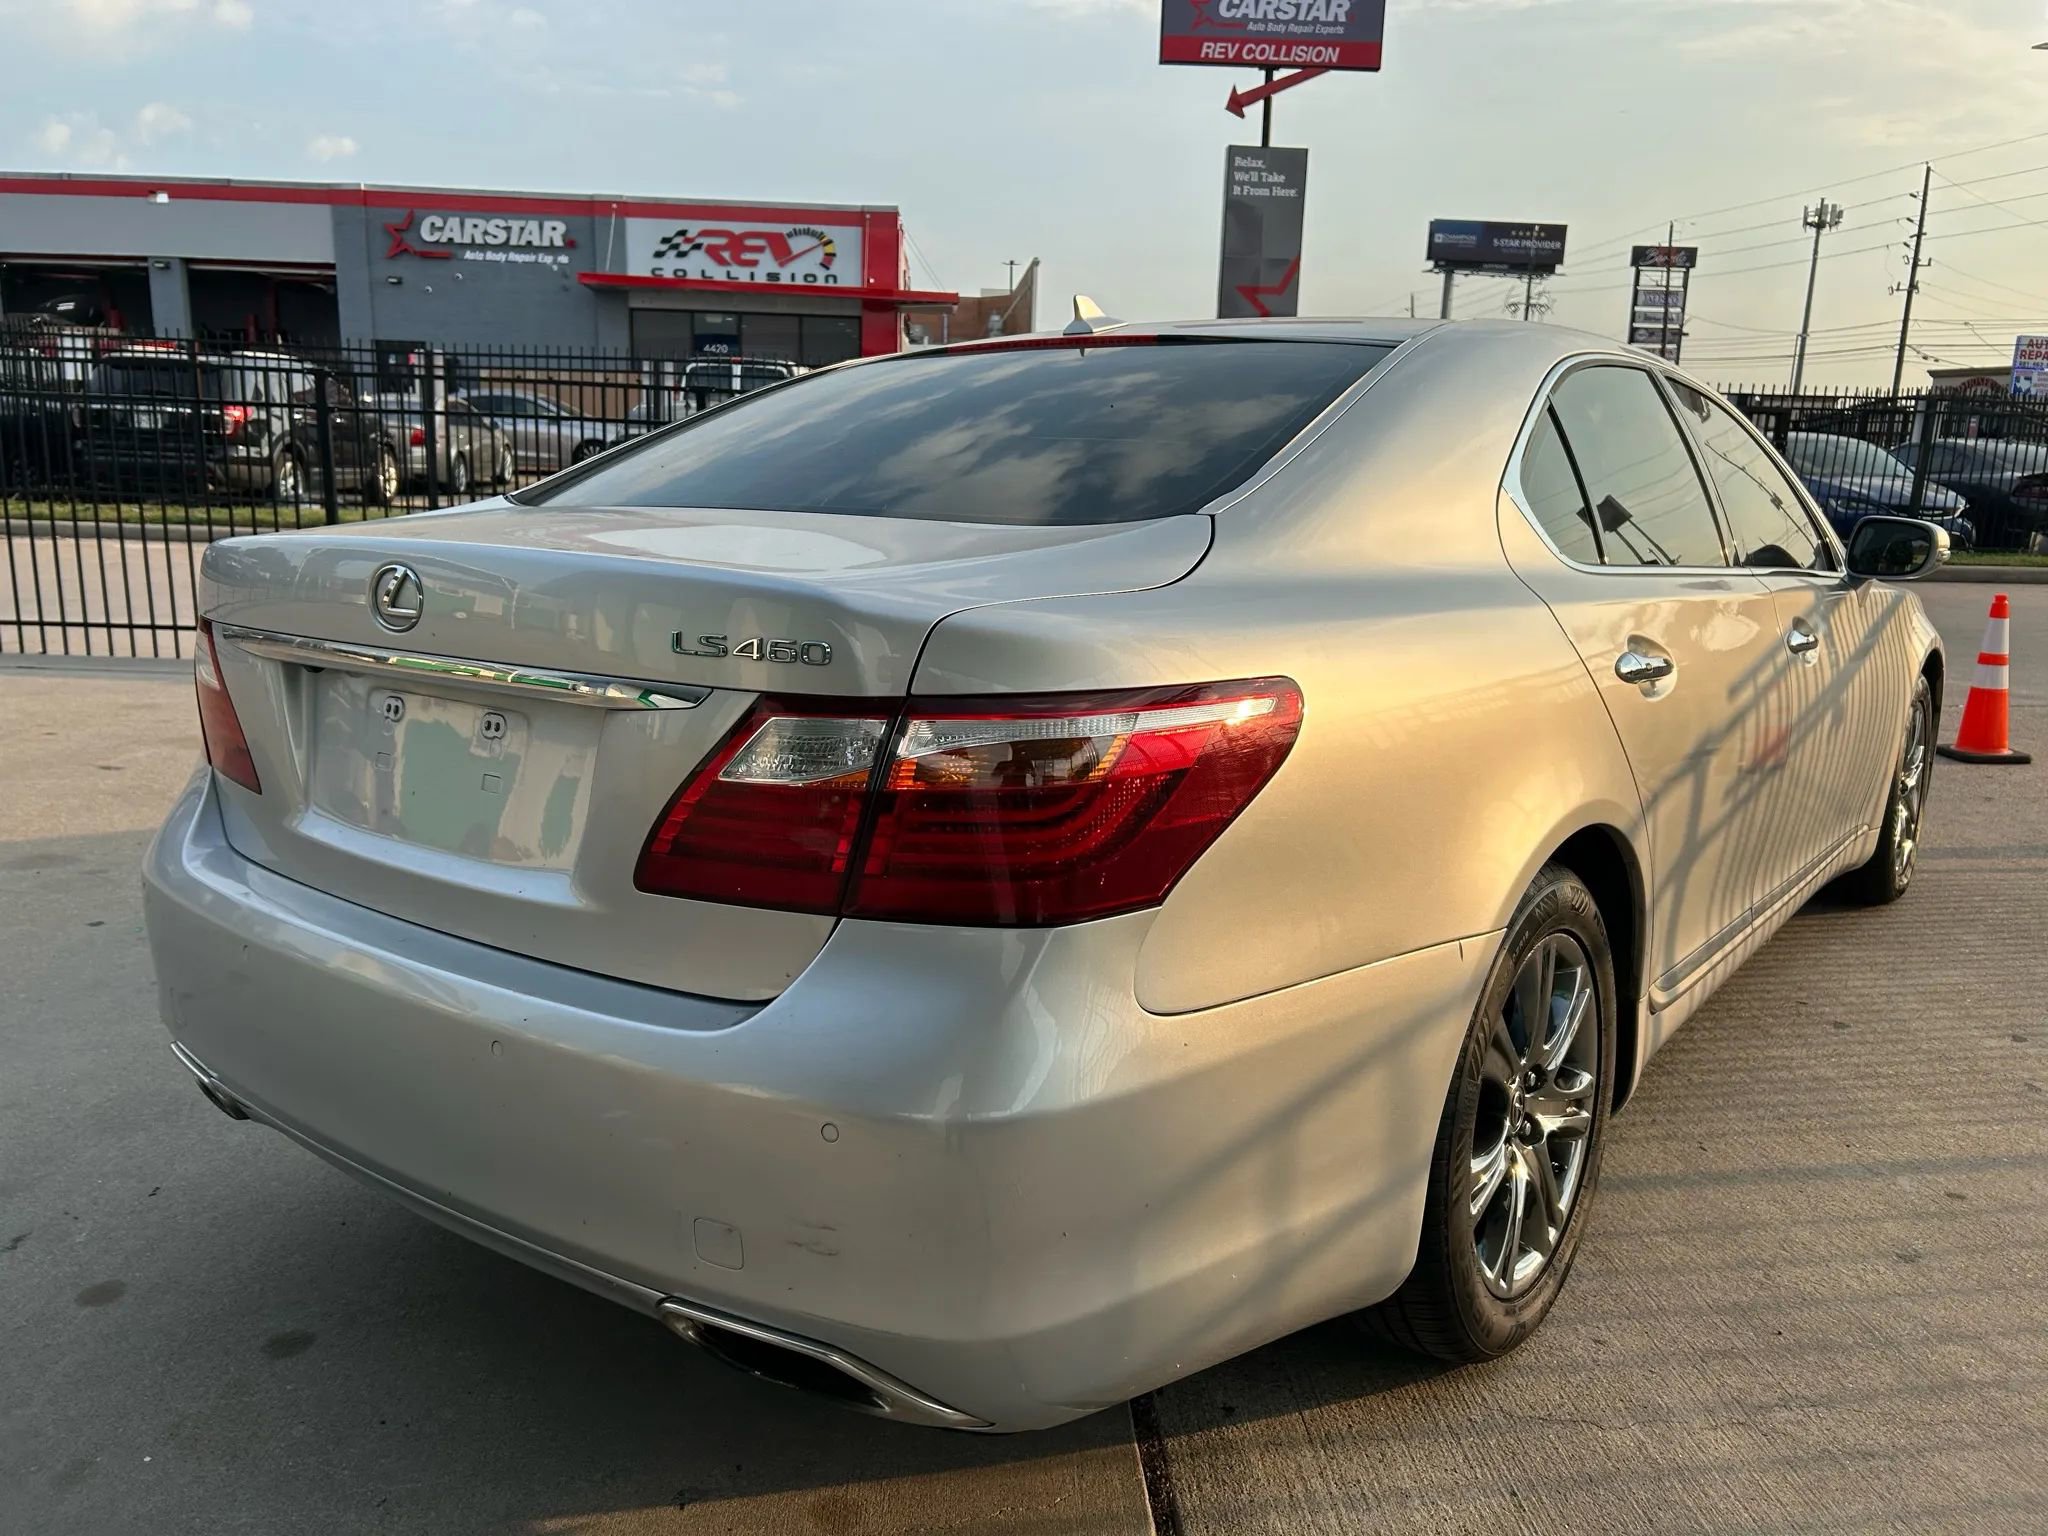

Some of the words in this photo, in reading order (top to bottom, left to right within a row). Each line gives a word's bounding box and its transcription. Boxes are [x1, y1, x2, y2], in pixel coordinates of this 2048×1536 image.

[1218, 0, 1350, 22] CARSTAR
[1247, 22, 1265, 31] Auto
[1266, 22, 1287, 34] Body
[1288, 23, 1314, 35] Repair
[1315, 24, 1344, 35] Experts
[1200, 42, 1239, 59] REV
[1241, 44, 1340, 63] COLLISION
[1260, 171, 1286, 183] Take
[1233, 185, 1241, 195] It
[1243, 185, 1270, 196] From
[420, 215, 567, 247] CARSTAR
[692, 229, 815, 268] REV
[1493, 238, 1520, 248] 5-STAR
[1521, 239, 1562, 250] PROVIDER
[464, 250, 485, 261] Auto
[485, 251, 507, 263] Body
[508, 252, 536, 263] Repair
[537, 253, 569, 264] Exprts
[651, 267, 838, 284] COLLISION
[703, 344, 729, 354] 4420
[672, 630, 728, 657] LS
[732, 637, 832, 666] 460
